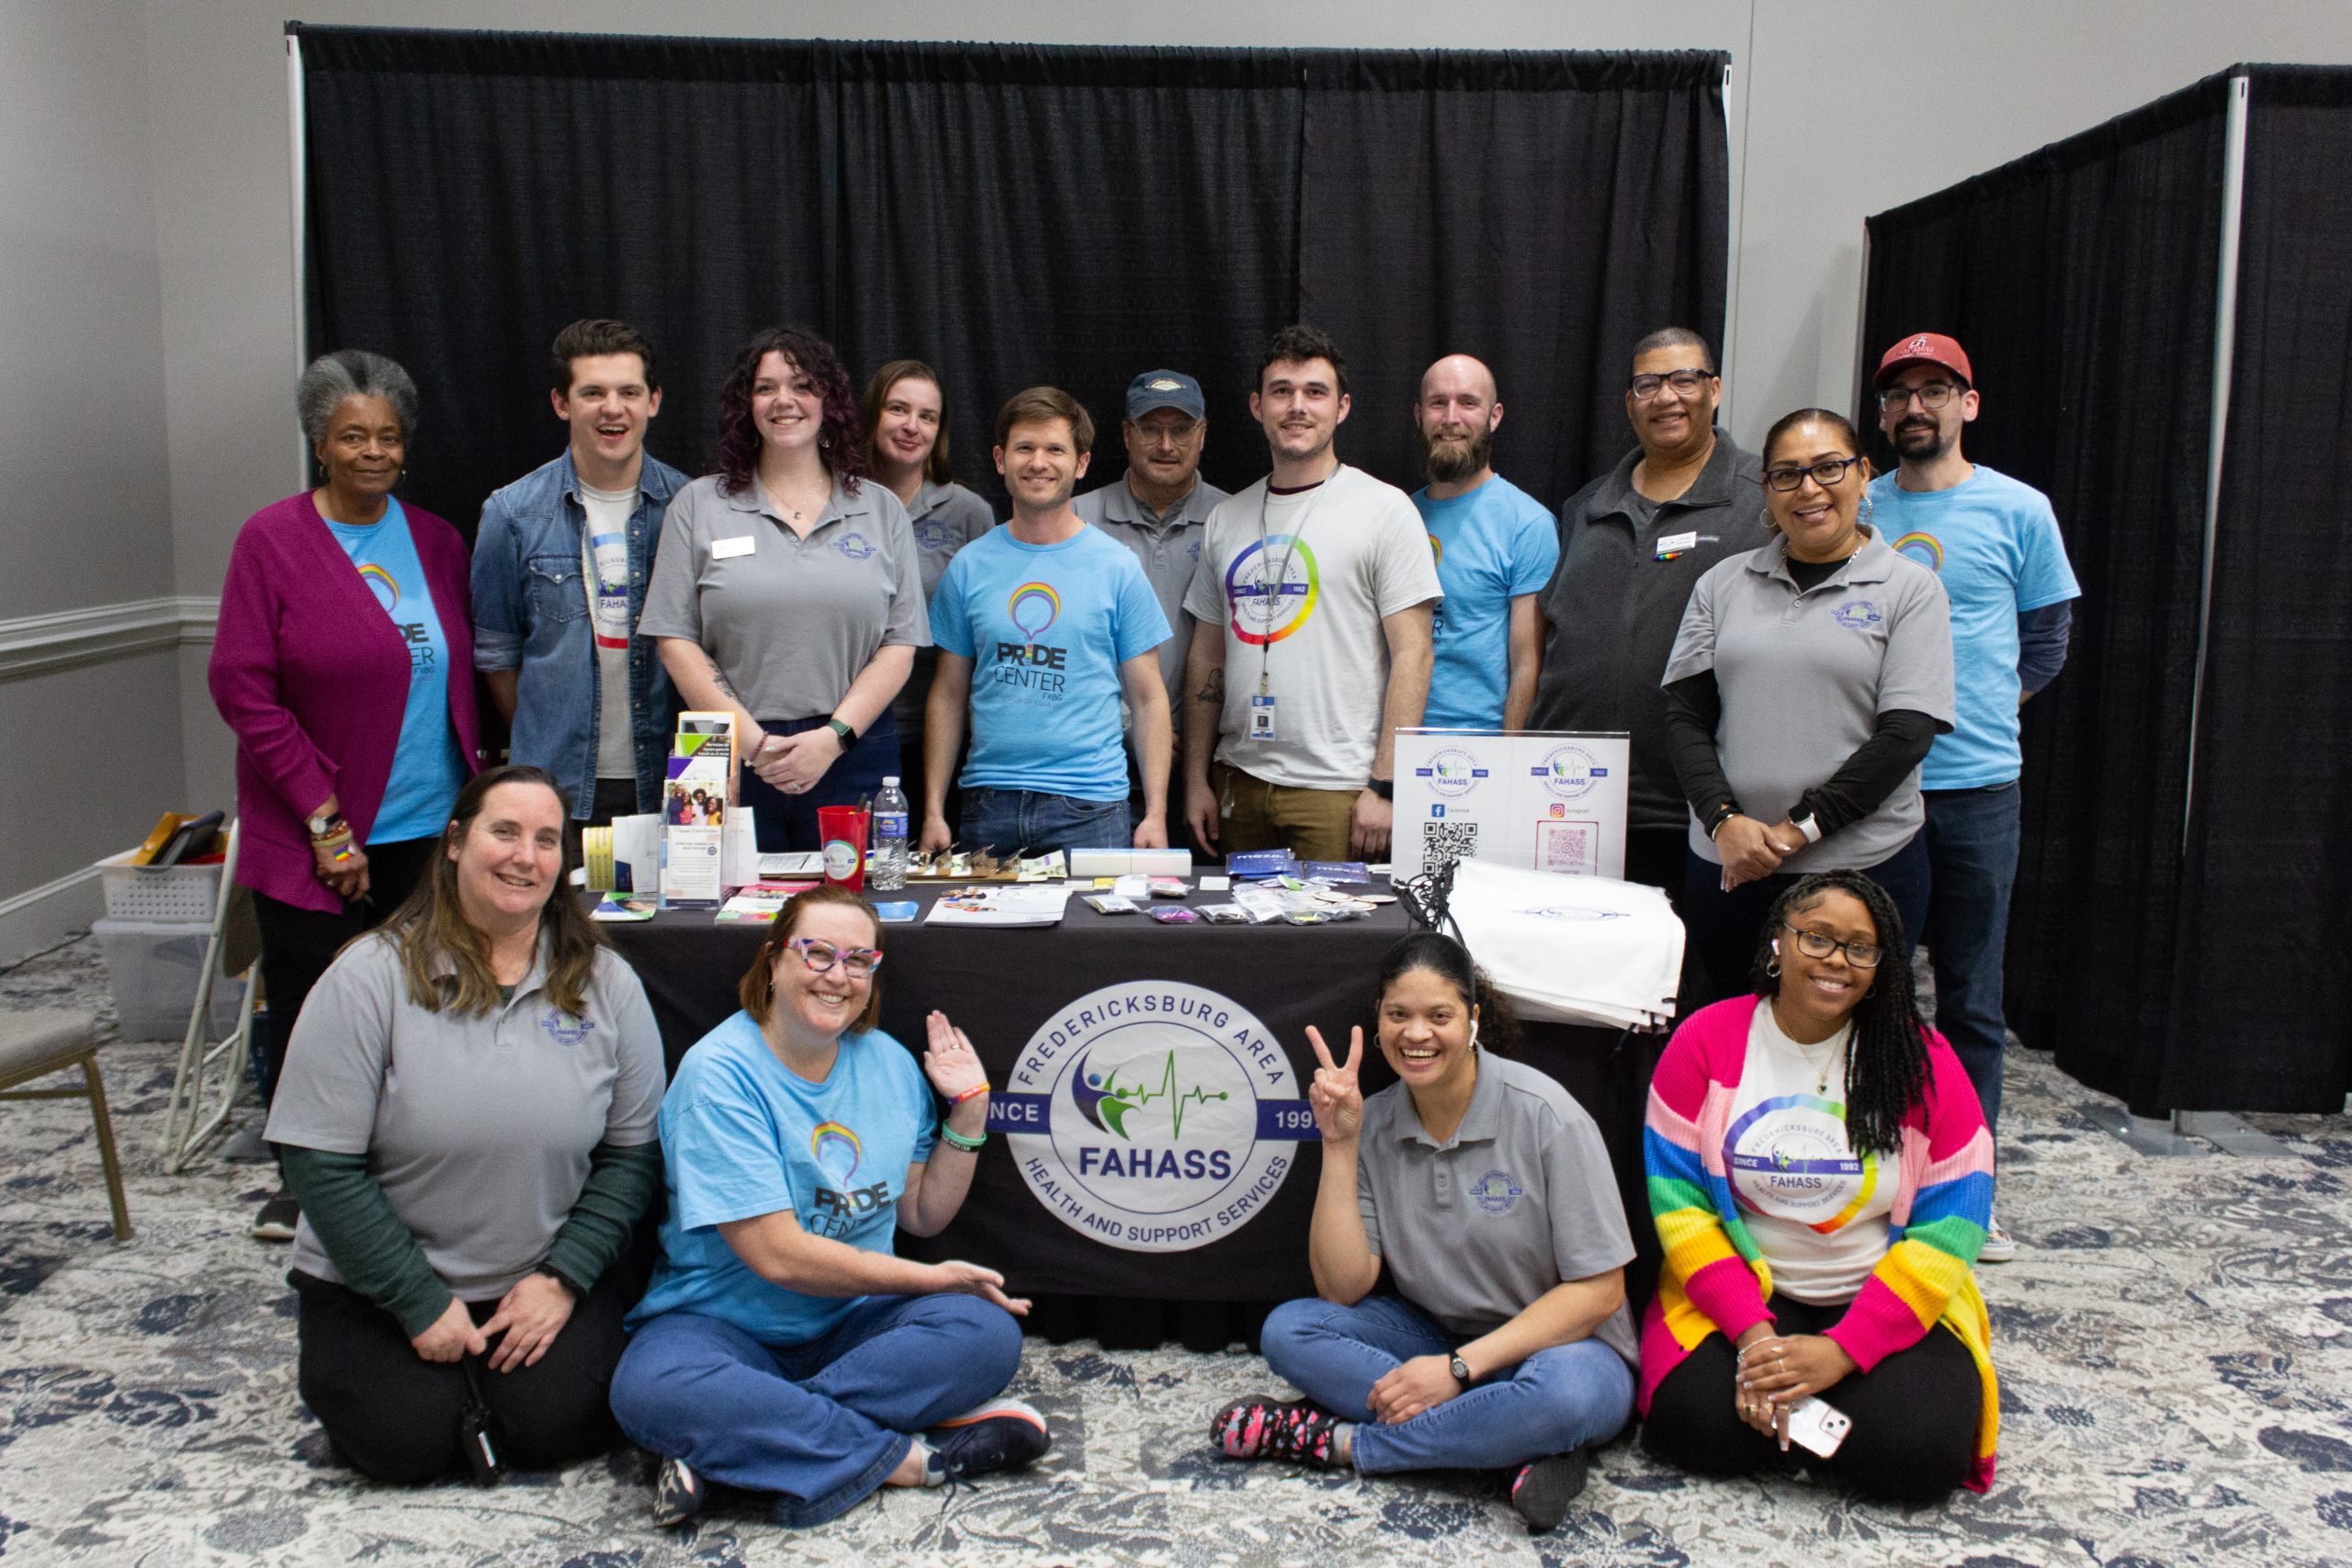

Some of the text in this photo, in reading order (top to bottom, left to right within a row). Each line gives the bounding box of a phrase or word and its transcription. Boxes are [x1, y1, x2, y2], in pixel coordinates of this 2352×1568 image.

[600, 600, 627, 608] FAHA
[1251, 597, 1280, 607] FAHAS
[997, 642, 1068, 671] PRIDE
[994, 665, 1066, 693] CENTER
[1016, 995, 1284, 1086] FREDERICKSBURG AREA
[989, 1102, 1039, 1122] NCE
[1275, 1111, 1319, 1129] 199
[1751, 1124, 1842, 1154] FREDERICKSBURG AREA
[1079, 1146, 1232, 1180] FAHASS
[1734, 1157, 1758, 1168] SINCE
[1839, 1162, 1860, 1171] 1992
[1770, 1176, 1822, 1189] FAHASS
[1774, 1197, 1790, 1206] AND
[1790, 1200, 1820, 1209] SUPPORT
[1822, 1179, 1847, 1204] SERVICES
[814, 1181, 890, 1218] PRIDE
[1024, 1155, 1288, 1243] HEALTH AND SUPPORT SERVICES
